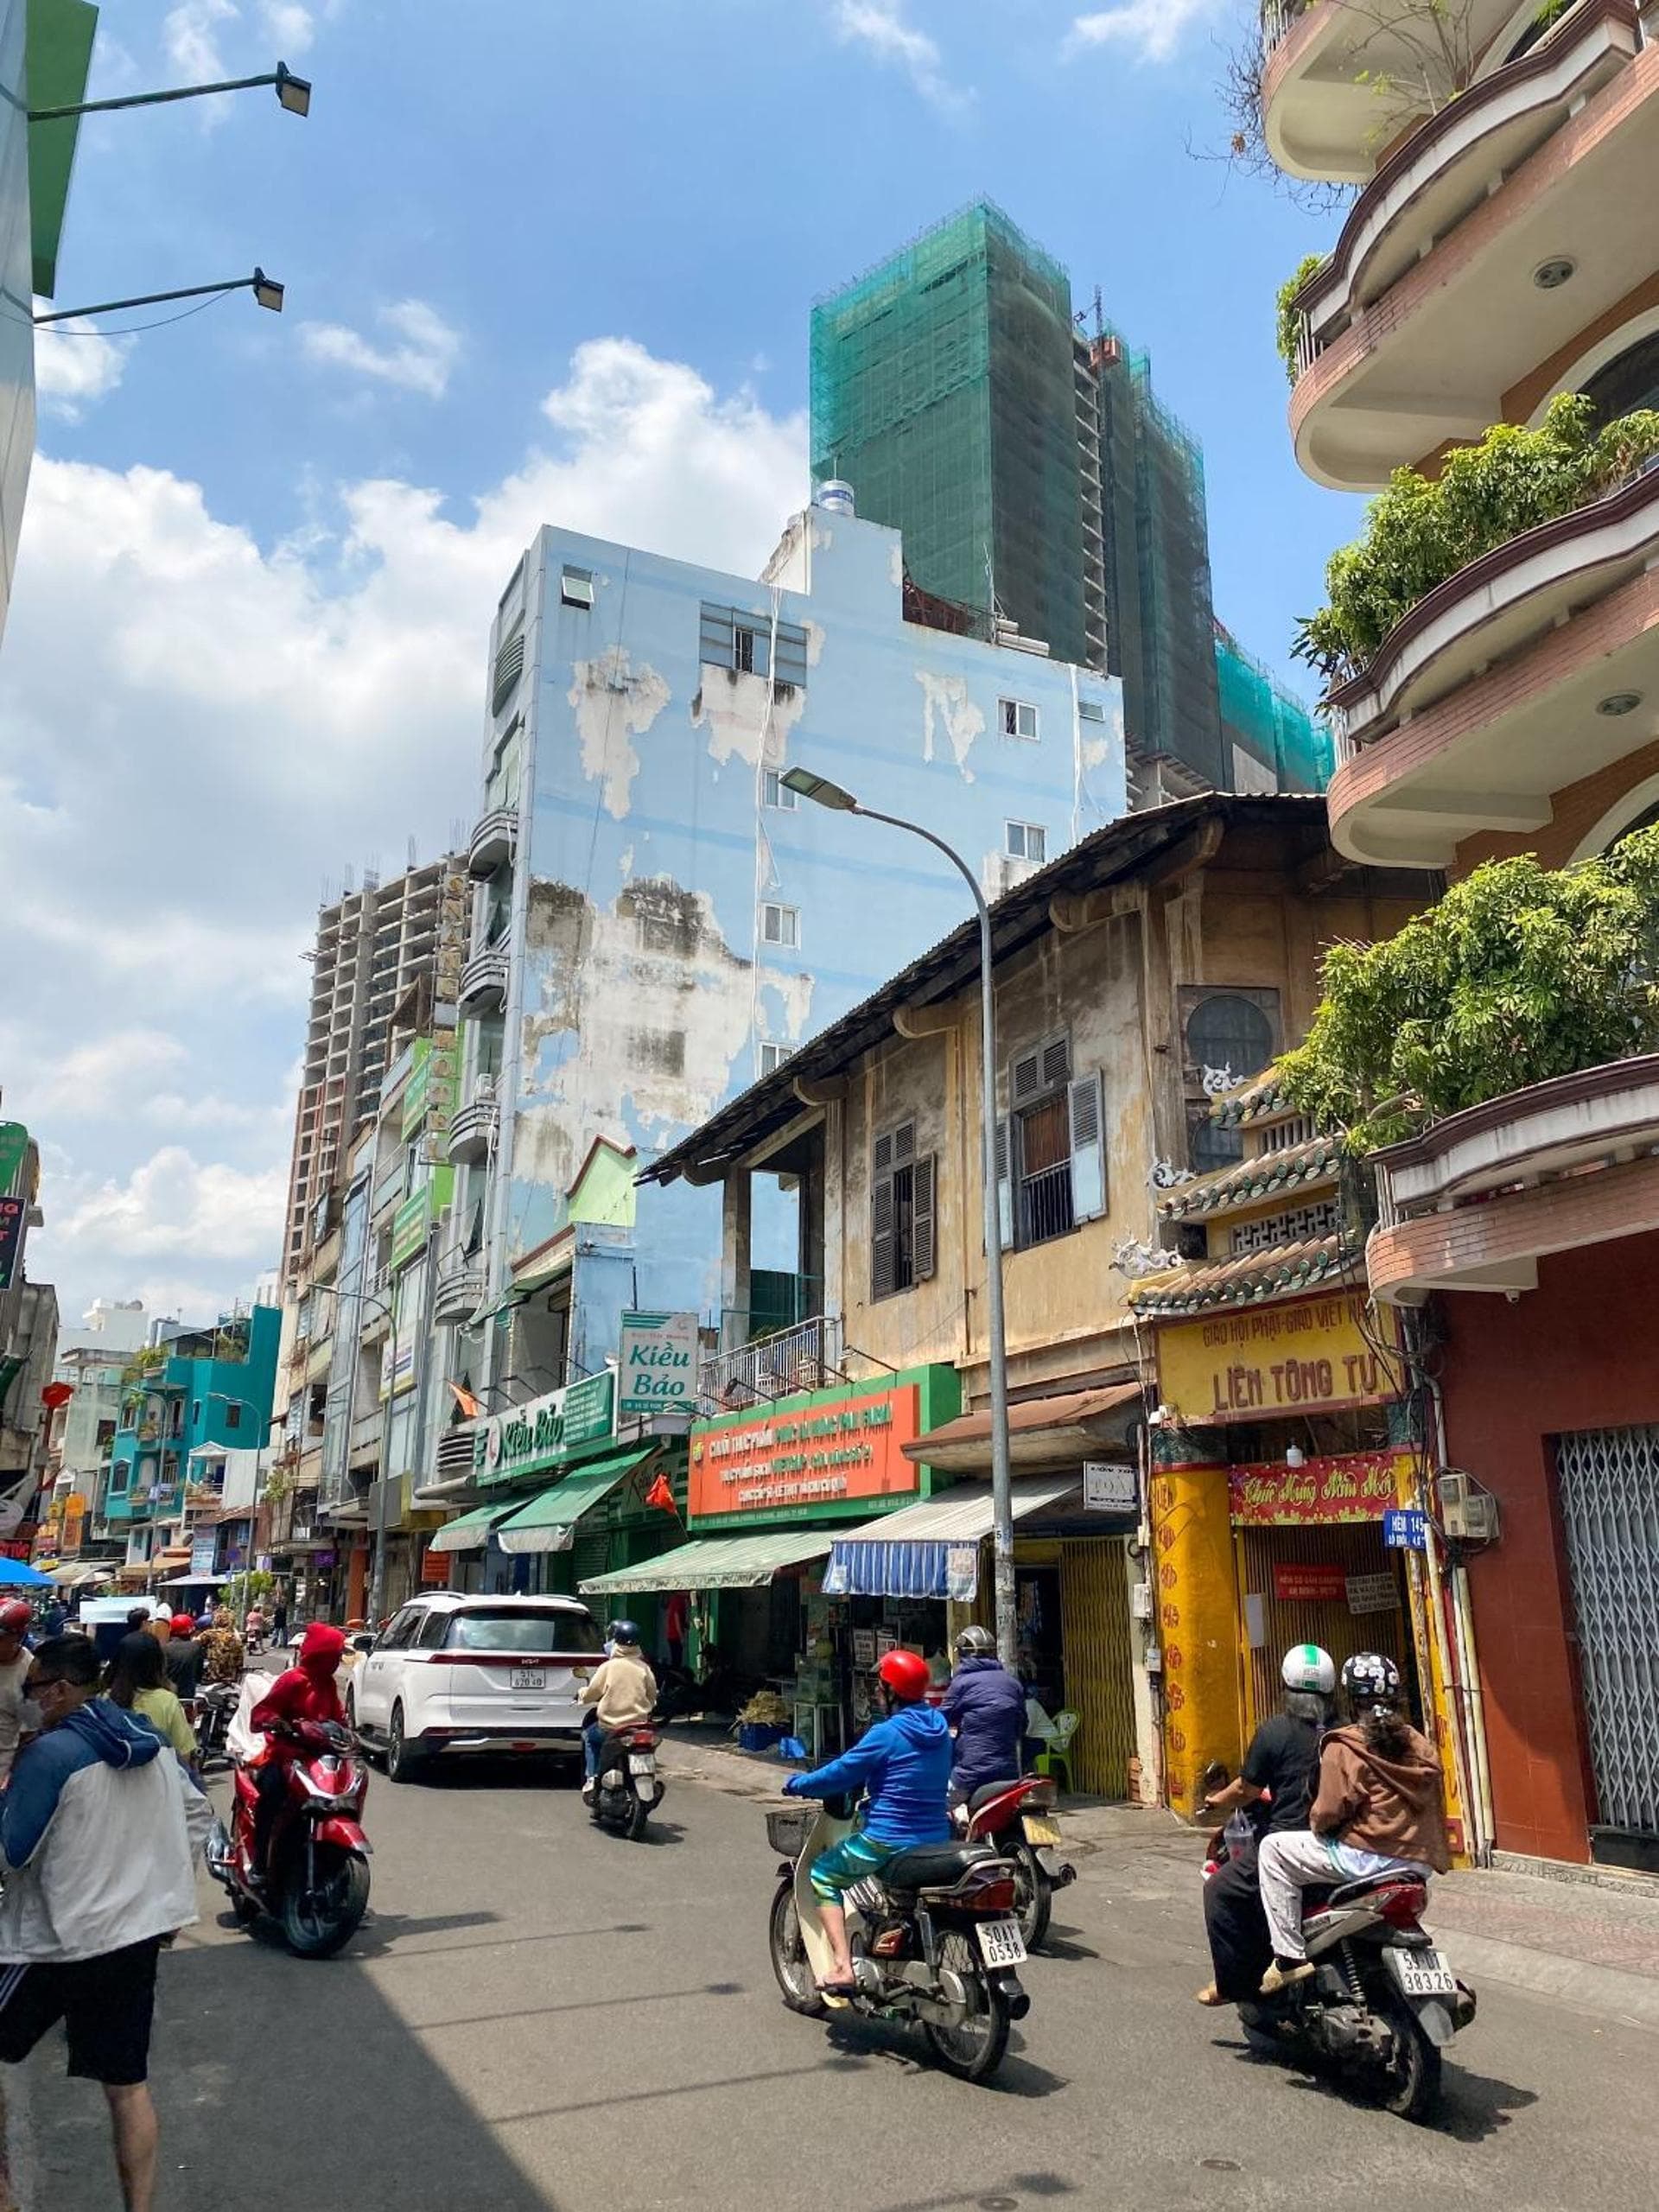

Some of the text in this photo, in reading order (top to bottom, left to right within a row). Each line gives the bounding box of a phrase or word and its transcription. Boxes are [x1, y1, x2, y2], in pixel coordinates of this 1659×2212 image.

[629, 1341, 690, 1367] Kiều
[633, 1374, 685, 1396] Bảo
[1213, 1363, 1264, 1410] LIÊN
[1269, 1358, 1333, 1403] TÔNG
[989, 1942, 1021, 1962] 0538
[1404, 1972, 1453, 1991] 383.26
